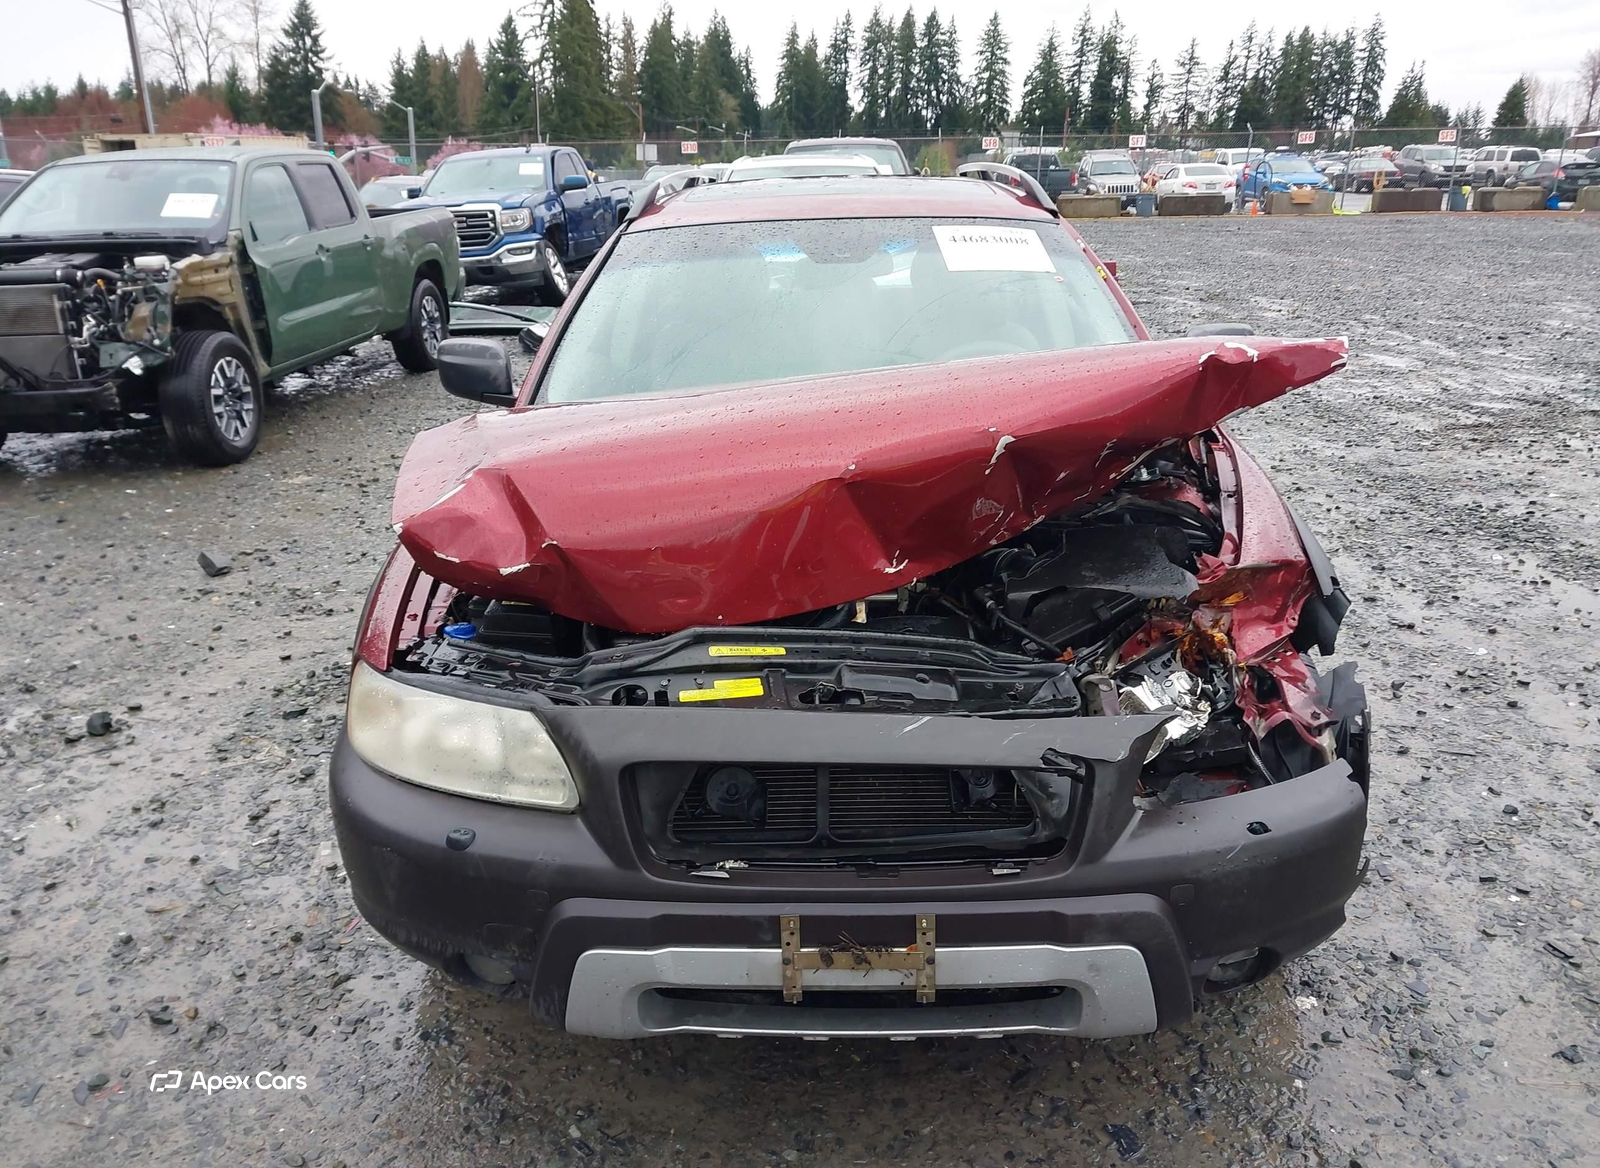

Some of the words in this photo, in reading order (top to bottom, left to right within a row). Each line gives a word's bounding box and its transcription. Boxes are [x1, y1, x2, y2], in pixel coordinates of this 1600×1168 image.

[1299, 133, 1314, 142] SF6
[1440, 131, 1455, 140] SF5
[983, 138, 998, 147] SF8
[1131, 137, 1144, 146] SF7
[682, 143, 697, 152] SF10
[948, 234, 1030, 246] 44683008
